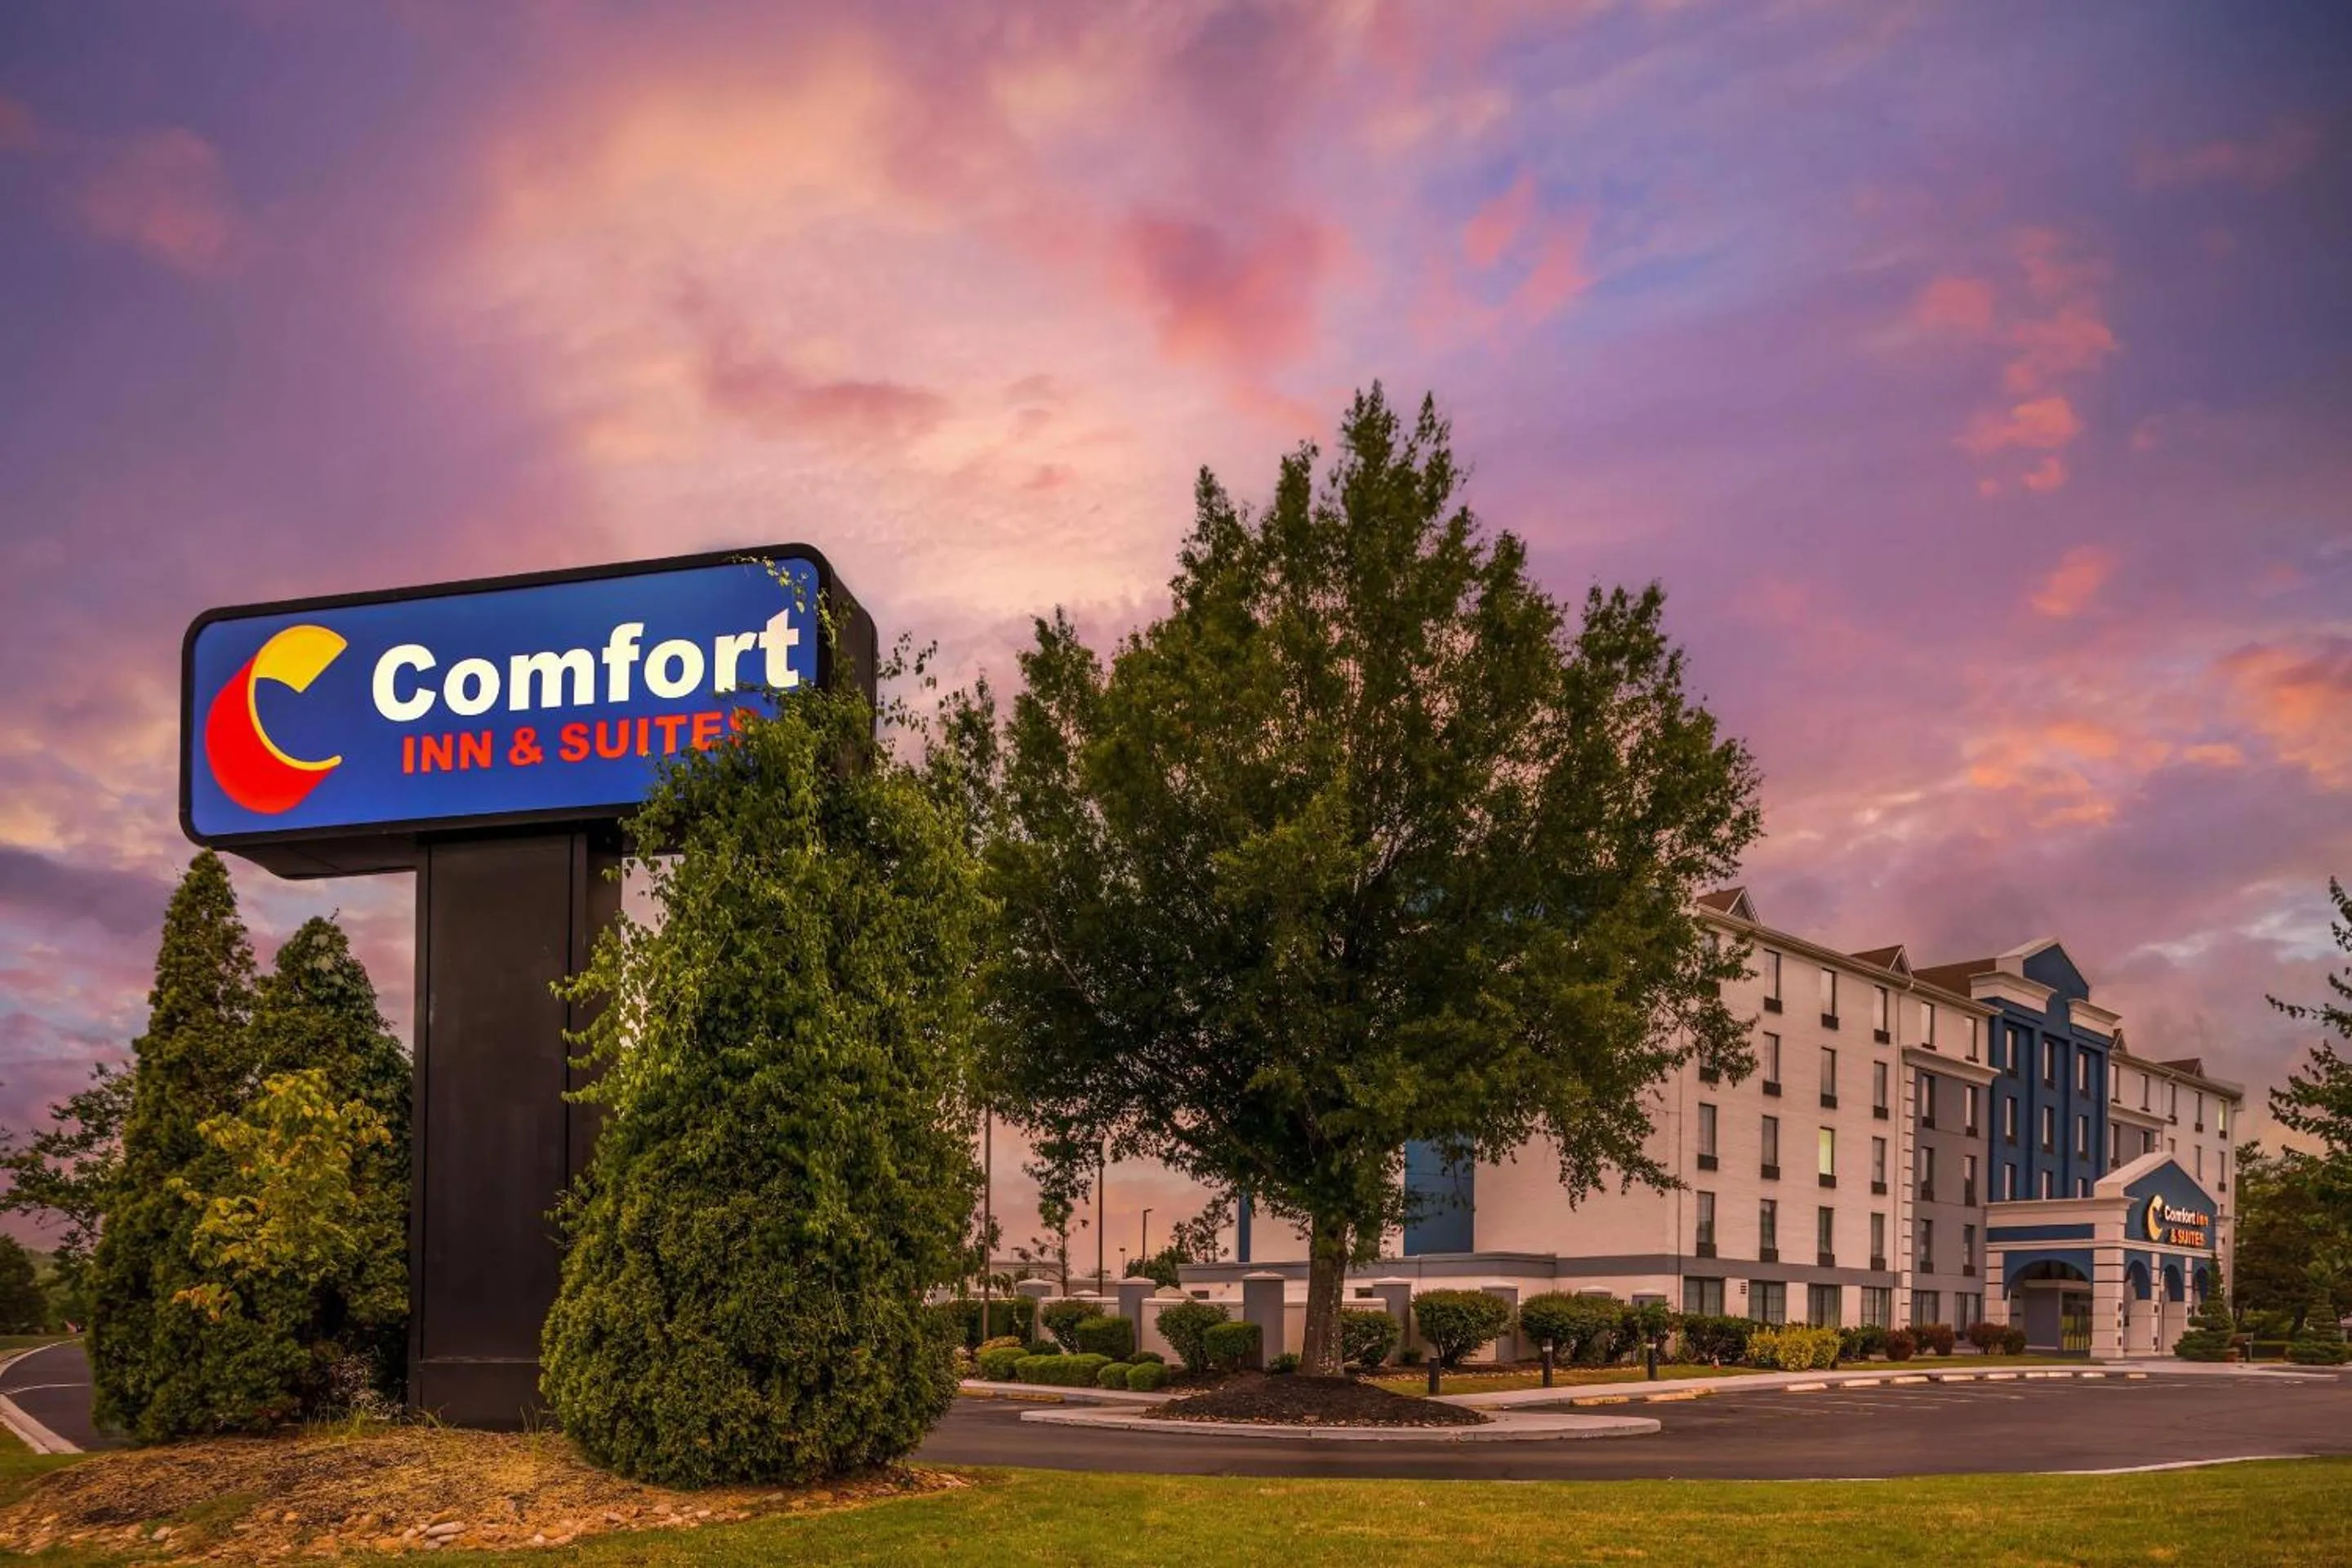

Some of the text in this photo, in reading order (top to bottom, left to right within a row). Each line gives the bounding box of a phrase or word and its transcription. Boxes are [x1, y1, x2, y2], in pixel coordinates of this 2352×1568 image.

[372, 608, 800, 722] Comfort
[401, 730, 492, 774] INN
[507, 727, 543, 767] &
[2164, 1205, 2196, 1225] Comfort
[2171, 1228, 2204, 1247] & SUITES
